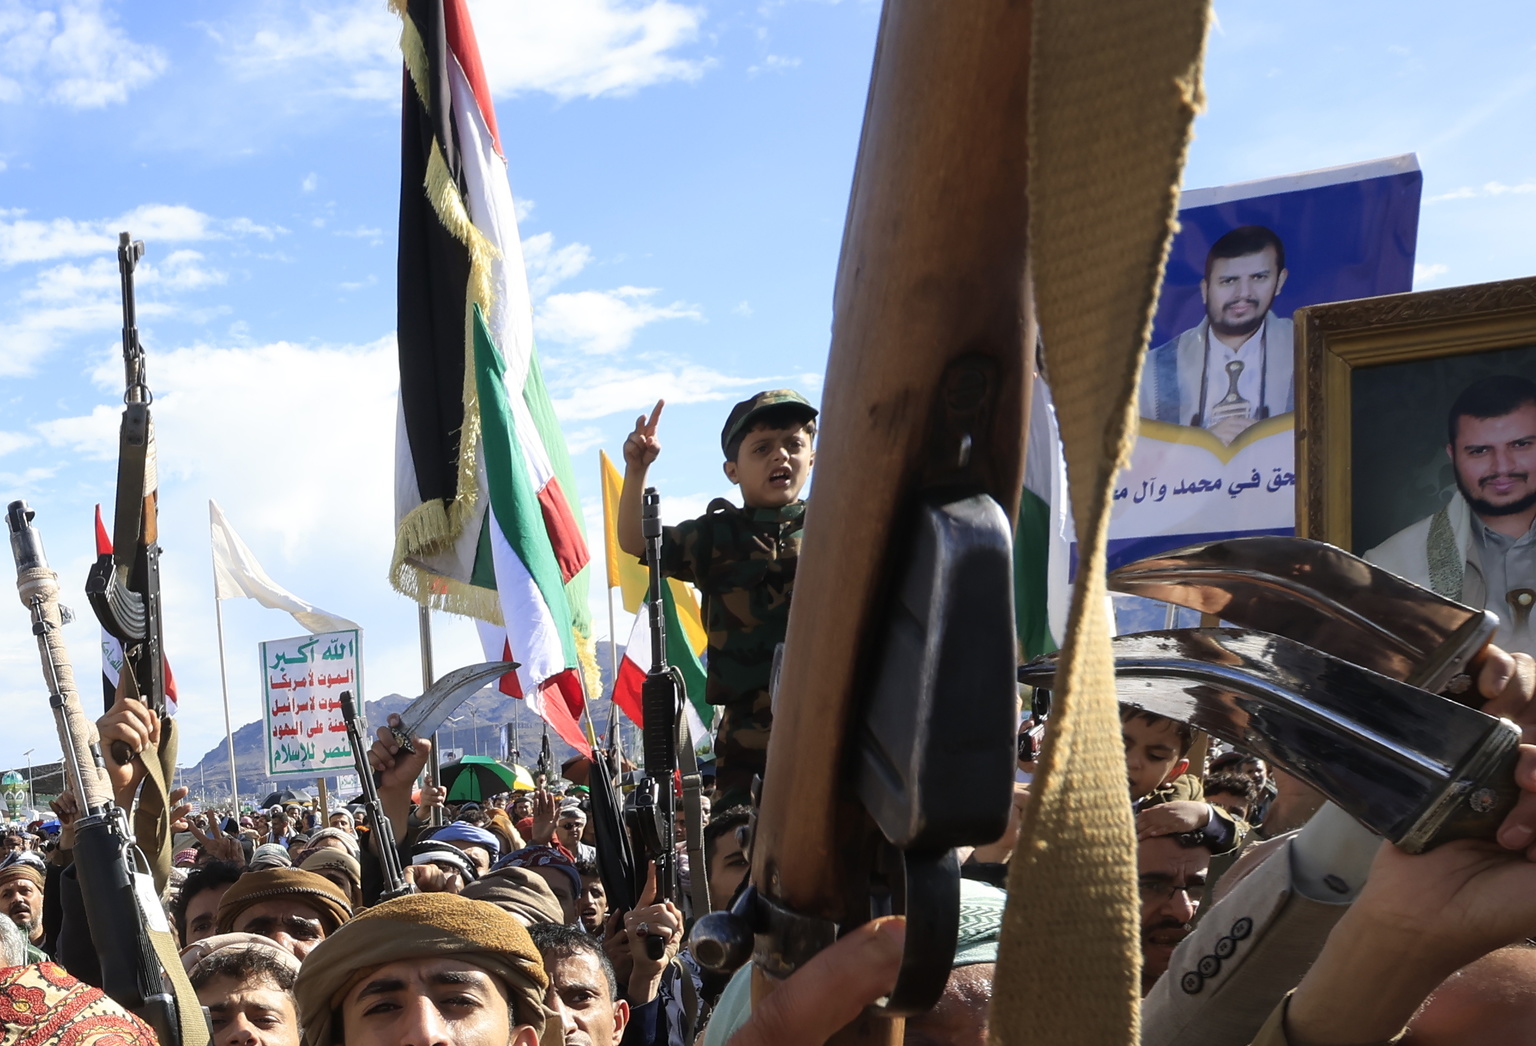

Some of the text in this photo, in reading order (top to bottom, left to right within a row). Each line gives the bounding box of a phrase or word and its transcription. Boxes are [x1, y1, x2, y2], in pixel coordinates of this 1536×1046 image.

[1133, 477, 1167, 504] وآل
[1173, 477, 1223, 495] محمد
[1228, 468, 1261, 499] في
[269, 636, 354, 672] الله أكبر
[318, 668, 354, 688] الموت
[273, 720, 303, 740] اليهود
[307, 719, 323, 738] على
[273, 737, 352, 767] لنصر للإسلام
